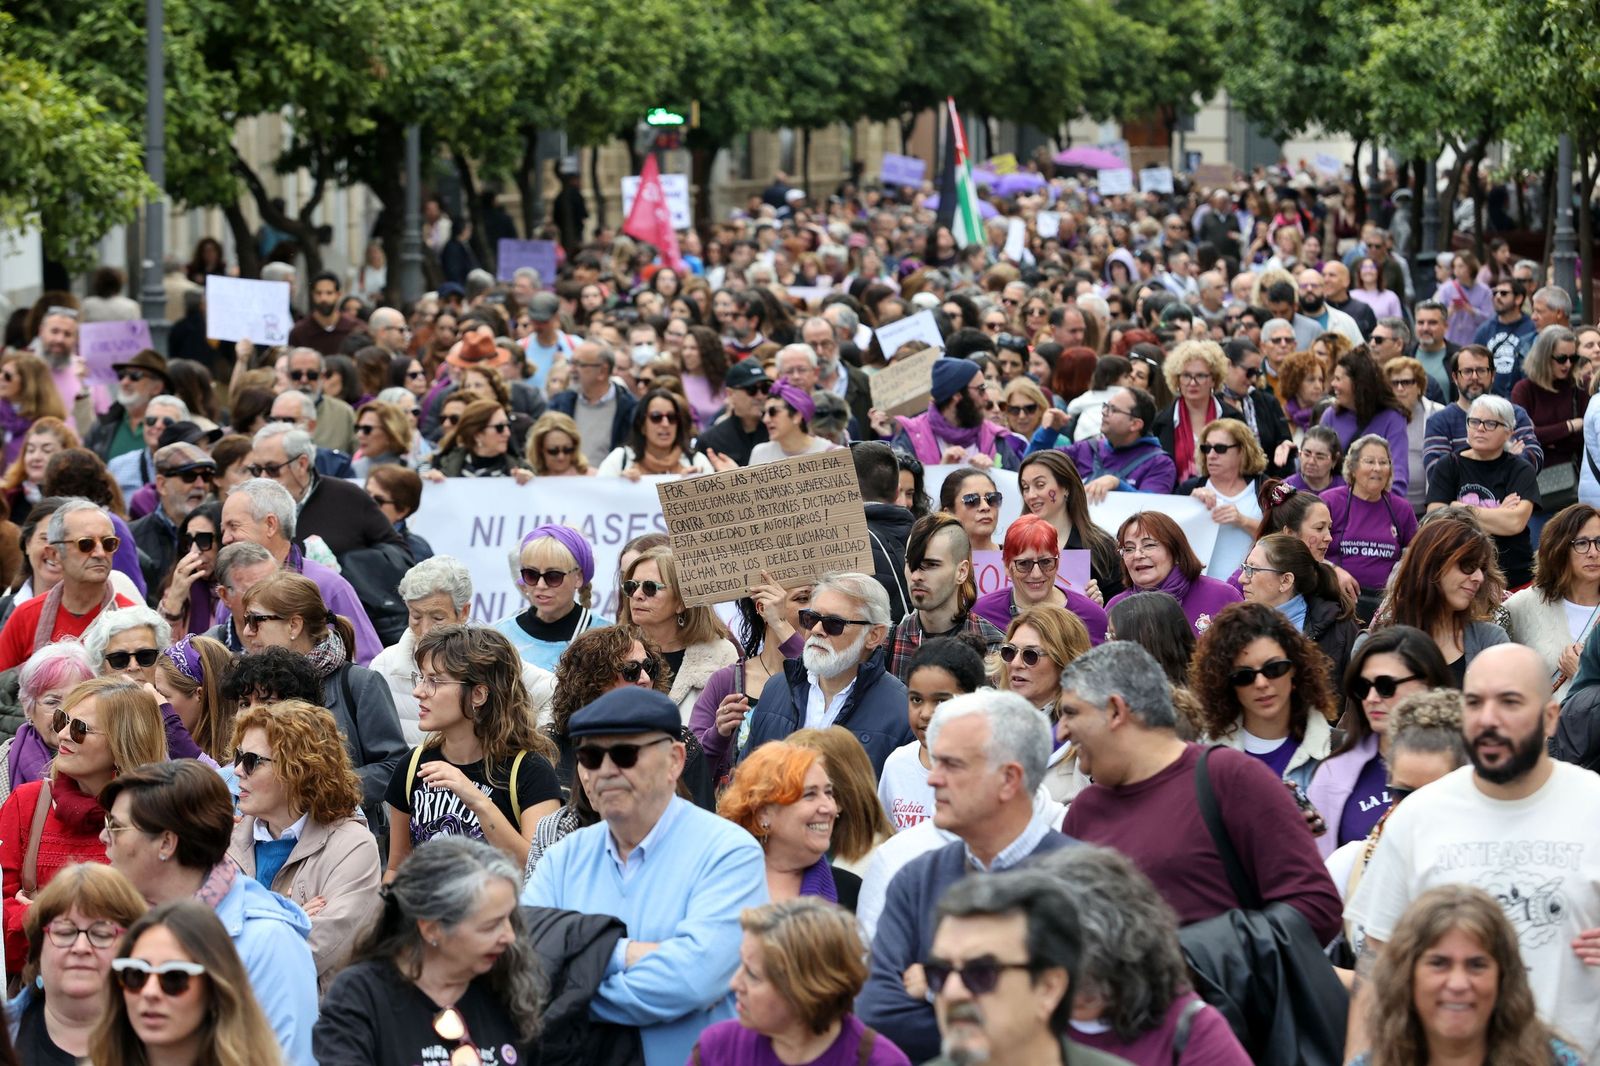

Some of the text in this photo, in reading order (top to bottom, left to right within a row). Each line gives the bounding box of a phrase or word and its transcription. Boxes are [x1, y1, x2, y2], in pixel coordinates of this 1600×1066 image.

[664, 484, 688, 500] POR
[691, 476, 726, 494] TODAS
[731, 473, 748, 487] LAS
[751, 464, 792, 484] MUJERES
[666, 490, 754, 516] REVOLUCIONARIAS,
[670, 516, 705, 534] CONTRA
[707, 509, 735, 525] TODOS
[738, 507, 755, 521] LOS
[757, 499, 800, 517] PATRONES
[803, 491, 846, 510] DICTADOS
[470, 516, 505, 547] NI
[581, 513, 668, 545] ASES
[674, 534, 698, 549] ESTA
[700, 526, 746, 543] SOCIEDAD
[750, 524, 760, 536] DE
[677, 524, 850, 567] VIVAN LAS MUJERES QUE LUCHARON Y
[680, 539, 866, 582] LUCHAN POR LOS IDEALES DE IGUALDAD
[1340, 547, 1359, 555] INO
[685, 586, 692, 597] Y
[802, 564, 816, 576] EN
[472, 592, 506, 624] NI
[1358, 795, 1381, 812] LA
[1436, 839, 1584, 872] ANTIFASCIST
